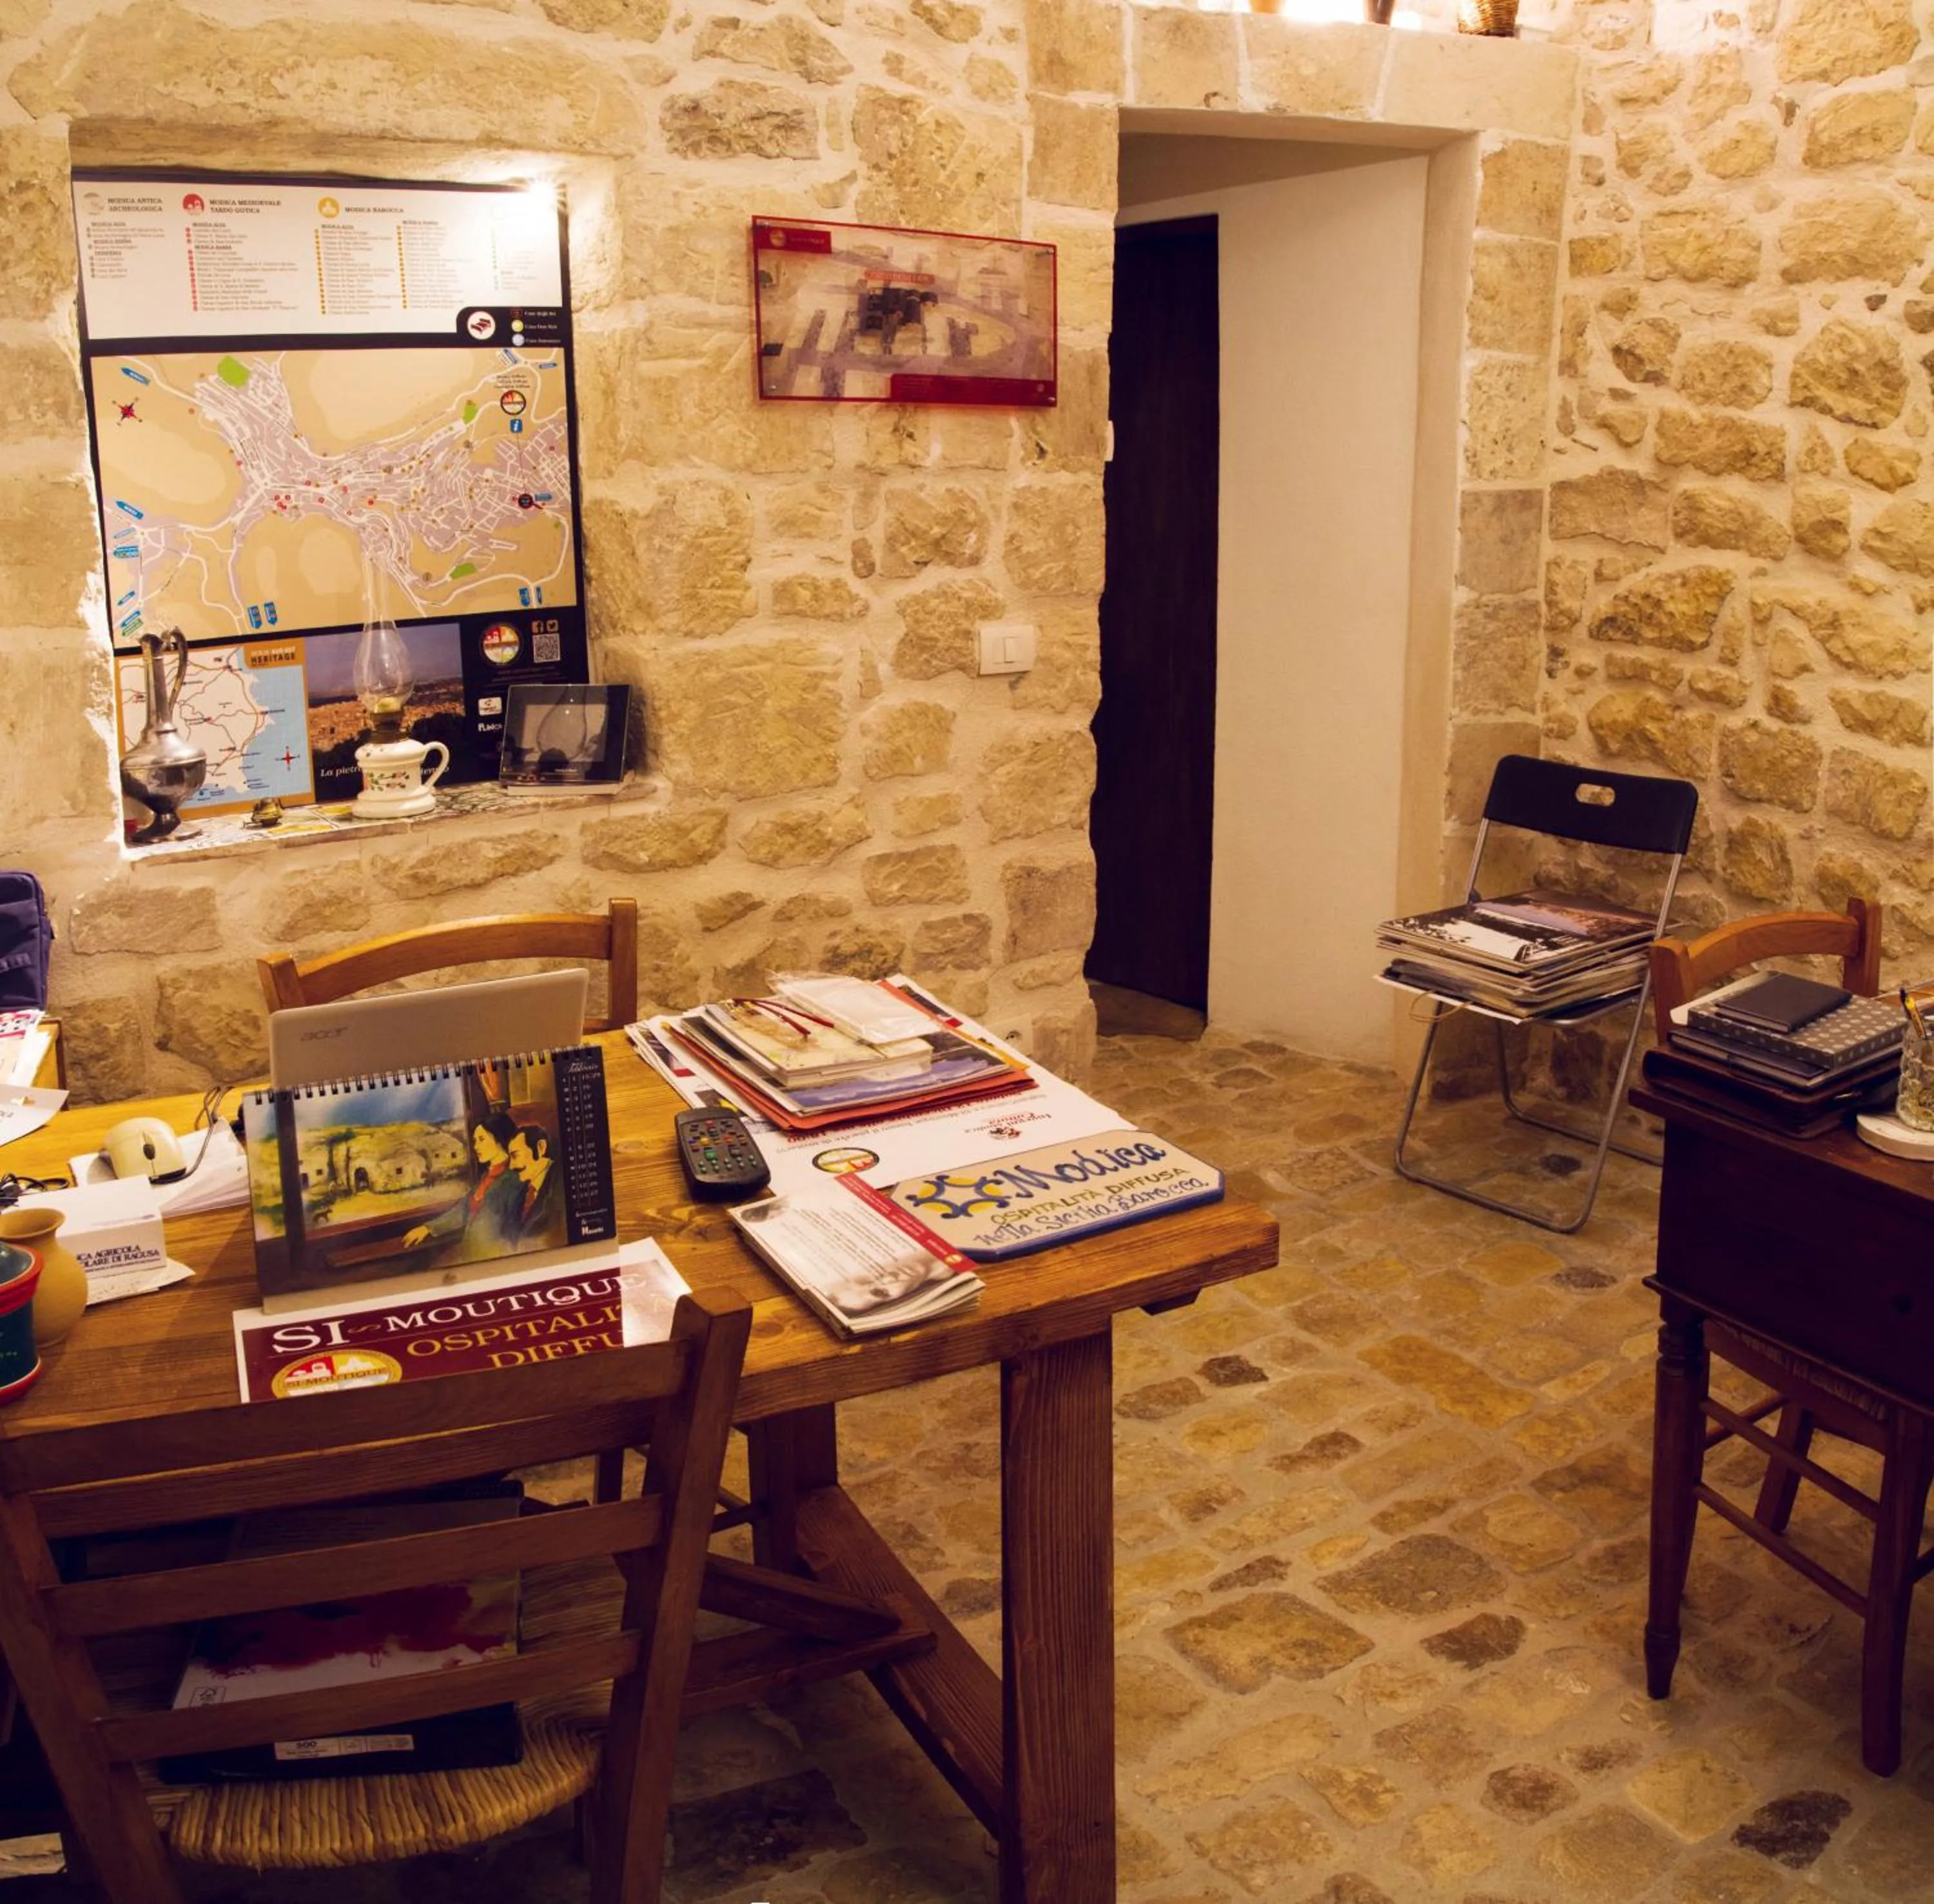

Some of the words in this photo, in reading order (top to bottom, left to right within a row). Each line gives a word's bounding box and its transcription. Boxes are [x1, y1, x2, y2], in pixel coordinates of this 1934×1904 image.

[251, 652, 295, 663] HERITAGE
[300, 1026, 348, 1042] acer
[993, 1143, 1167, 1198] Modica
[1105, 1168, 1191, 1195] DIFFUSA
[95, 1244, 141, 1259] AGRICOLA
[112, 1254, 122, 1263] DI
[122, 1248, 160, 1261] RAGUSA
[271, 1319, 351, 1354] SI
[384, 1273, 647, 1332] MOUTIQUE
[407, 1303, 625, 1357] OSPITALI
[486, 1329, 625, 1369] DIFFU
